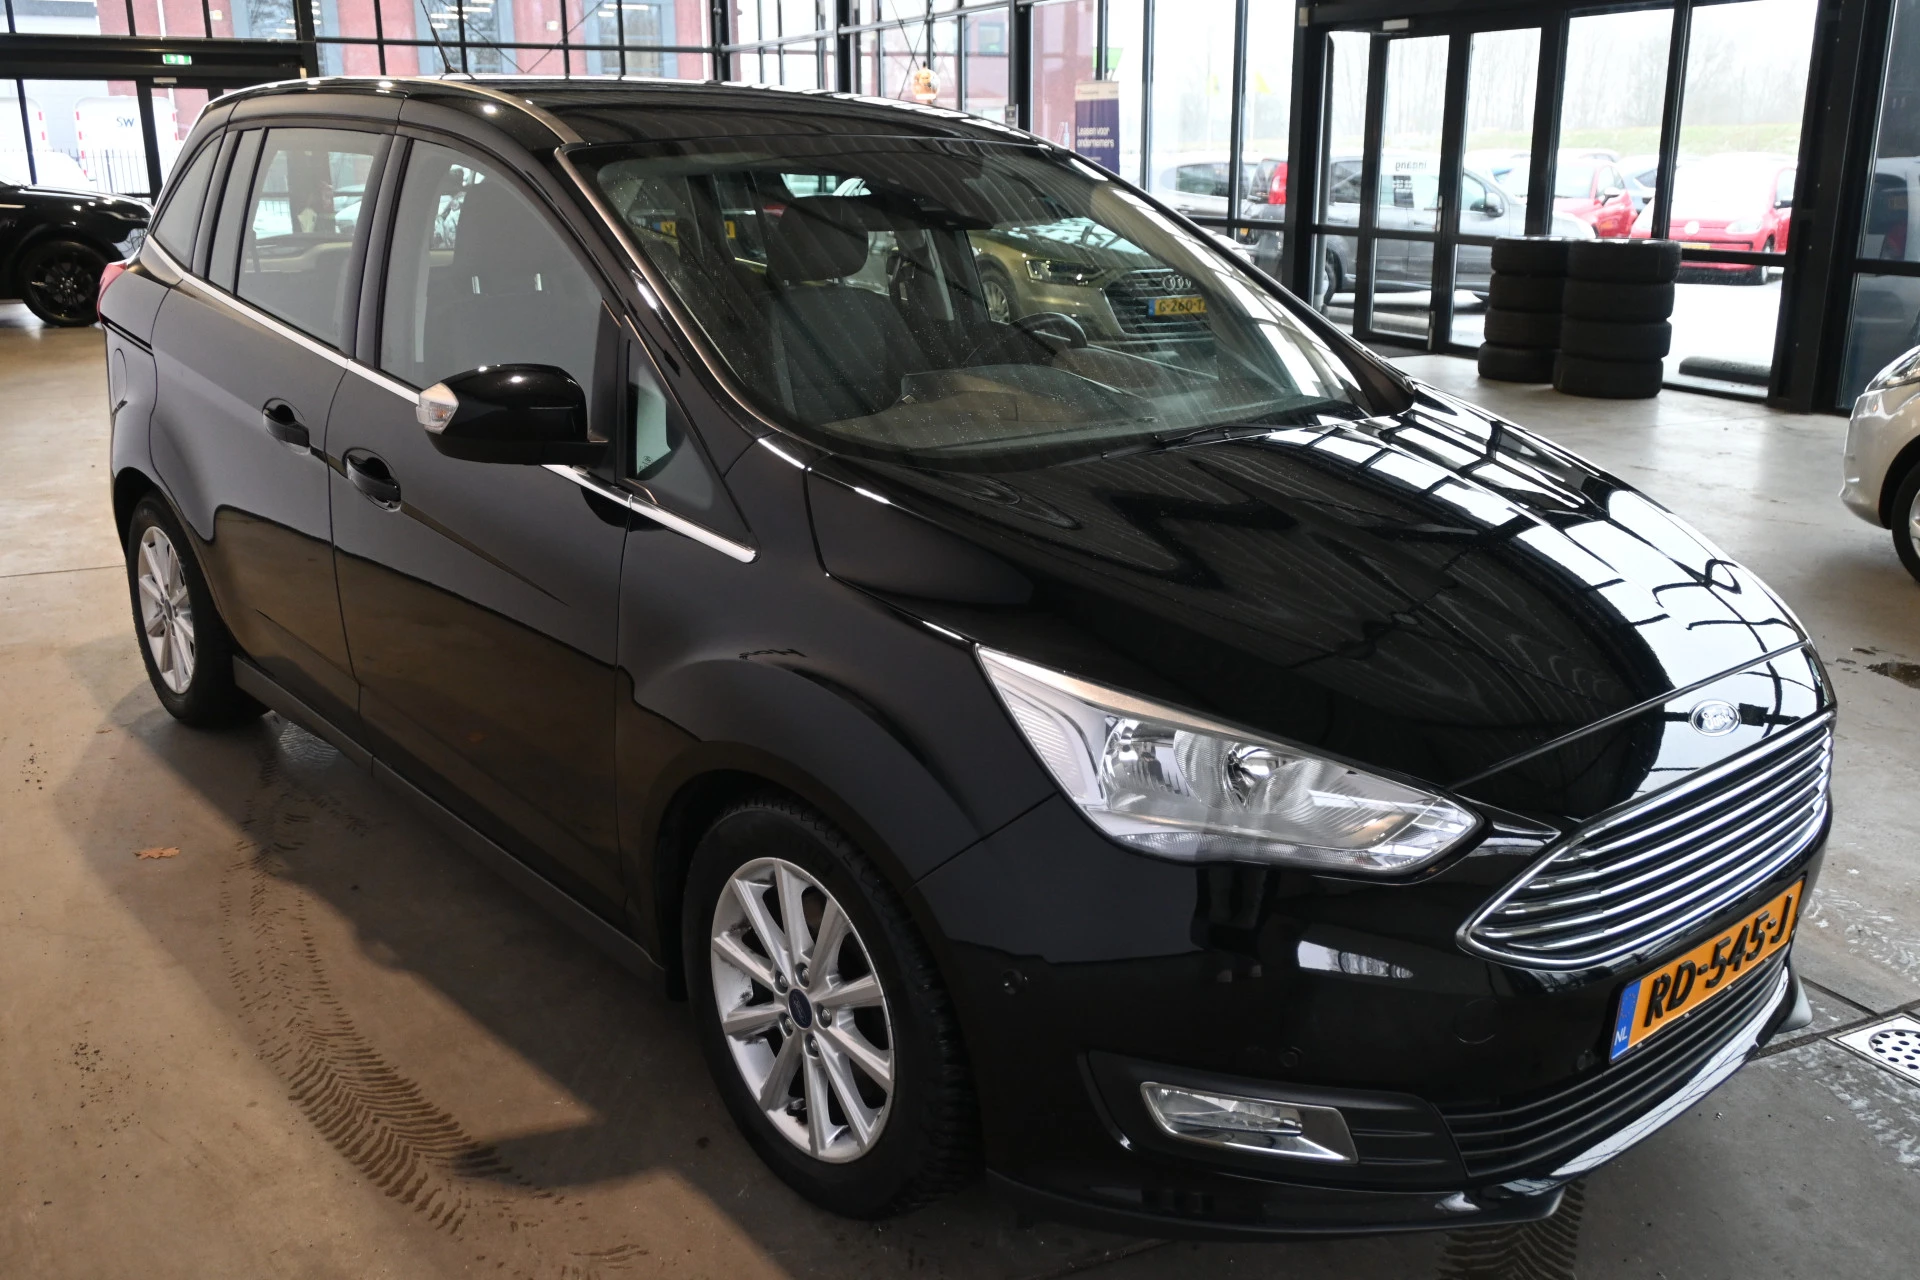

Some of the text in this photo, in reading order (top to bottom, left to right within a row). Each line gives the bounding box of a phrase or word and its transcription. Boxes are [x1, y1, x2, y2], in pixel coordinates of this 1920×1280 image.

[116, 116, 135, 128] SW
[1076, 126, 1110, 137] Leasen voor
[1076, 137, 1115, 149] ondernemers
[1643, 894, 1793, 1028] RD-545-J
[1614, 1027, 1628, 1046] NL
